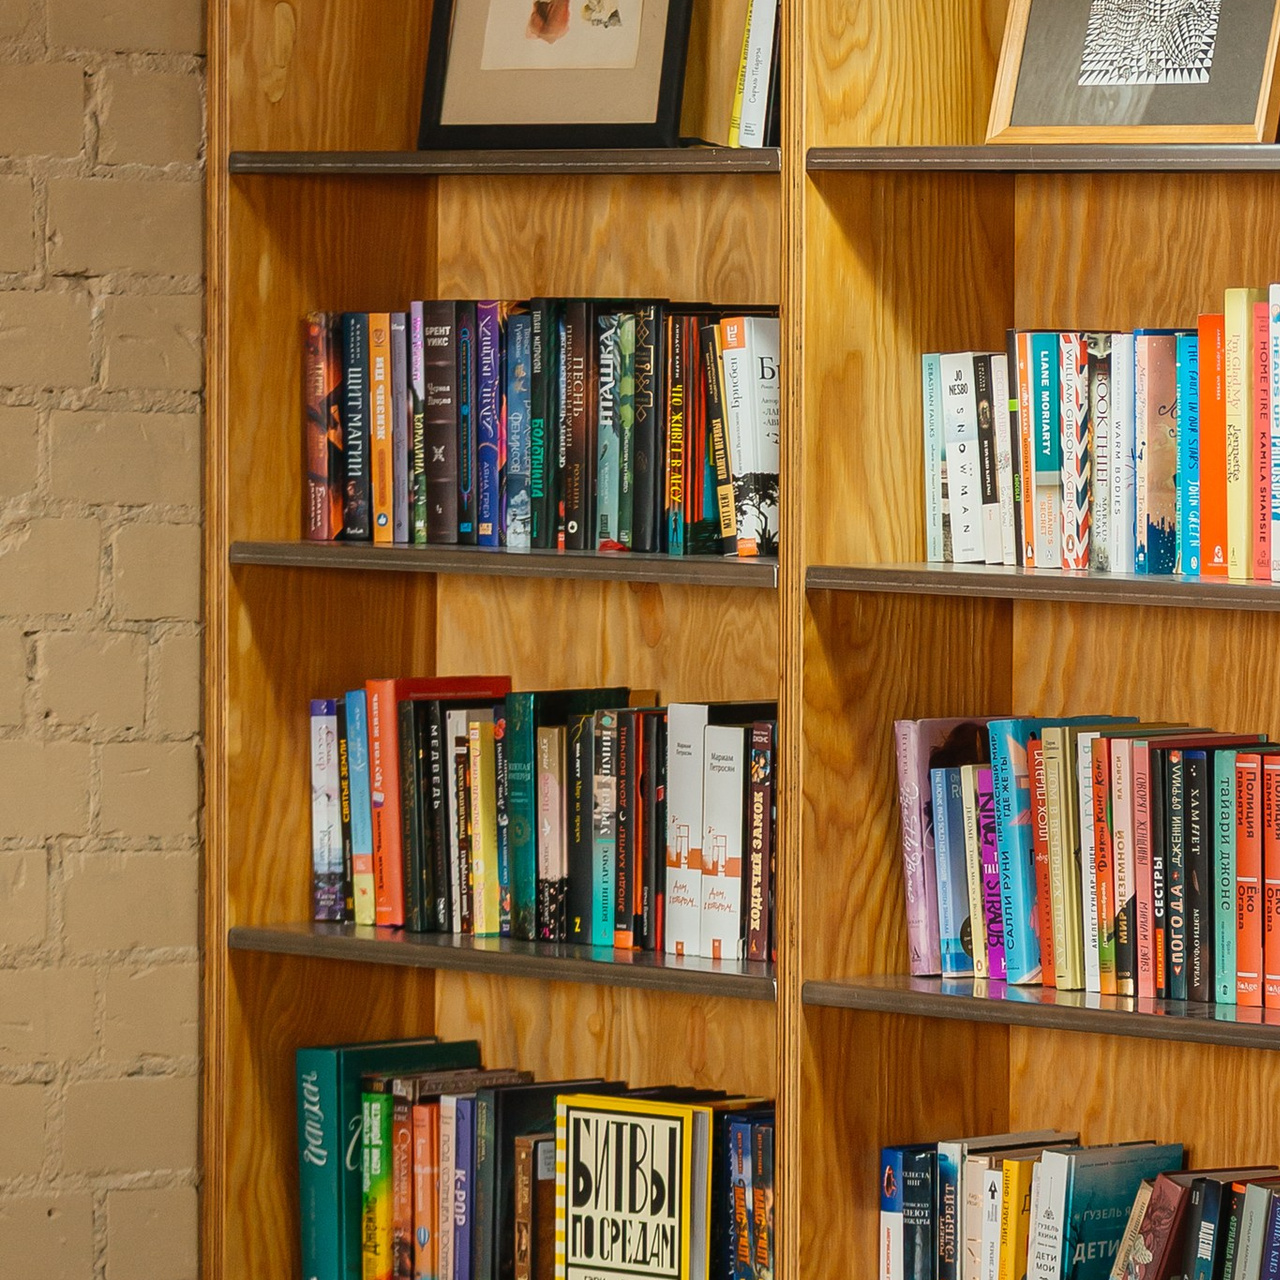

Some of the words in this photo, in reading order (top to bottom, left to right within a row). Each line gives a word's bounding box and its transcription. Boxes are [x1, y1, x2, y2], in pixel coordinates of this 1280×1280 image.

[426, 326, 451, 335] БРЕНТ
[1188, 344, 1198, 365] THE
[600, 327, 614, 425] ПТАШКА
[730, 357, 741, 408] Брисбен
[1041, 351, 1050, 386] LIANE
[1065, 349, 1075, 404] WILLIAM
[1189, 370, 1199, 397] FAULT
[1260, 341, 1268, 383] HOME
[348, 367, 361, 409] ЩИТ
[671, 385, 682, 406] ЧТО
[1096, 372, 1109, 428] BOOK
[1188, 402, 1198, 413] IN
[1260, 389, 1268, 420] FIRE
[348, 414, 362, 476] МАГИИ
[414, 414, 423, 474] КОРАЛИНА
[1041, 391, 1050, 455] MORIARTY
[1066, 409, 1076, 461] GIBSON
[1188, 419, 1198, 434] OUR
[1096, 431, 1109, 487] THIEF
[1188, 440, 1199, 470] STARS
[1259, 431, 1267, 482] KAMILA
[670, 472, 682, 502] ЛЕСУ
[1066, 471, 1075, 527] AGENCY
[1187, 479, 1199, 506] JOHN
[1189, 511, 1200, 547] GREEN
[1259, 486, 1267, 543] SHAMSIE
[340, 739, 348, 778] ЗЕМЛИ
[431, 724, 441, 809] МЕДВЕДЬ
[619, 727, 627, 776] ВОЛЧИЦ
[341, 779, 350, 822] СВЯТЫЕ
[619, 780, 627, 807] ДОМ
[753, 792, 764, 849] ЗАМОК
[750, 852, 763, 931] ХОДЯЧИЙ
[1001, 851, 1011, 890] РУНИ
[1115, 830, 1126, 907] НЕЗЕМНОЙ
[1154, 856, 1164, 917] СЕСТРЫ
[1004, 894, 1014, 950] САЛЛИ
[1118, 912, 1128, 944] МИР
[1172, 884, 1183, 963] ПОГОДА
[572, 1117, 677, 1219] БИТВЫ
[454, 1169, 466, 1226] K-POP
[945, 1183, 956, 1263] ГЭЛБРЕЙТ
[572, 1214, 595, 1259] ПО
[599, 1218, 676, 1269] СРЕДАМ
